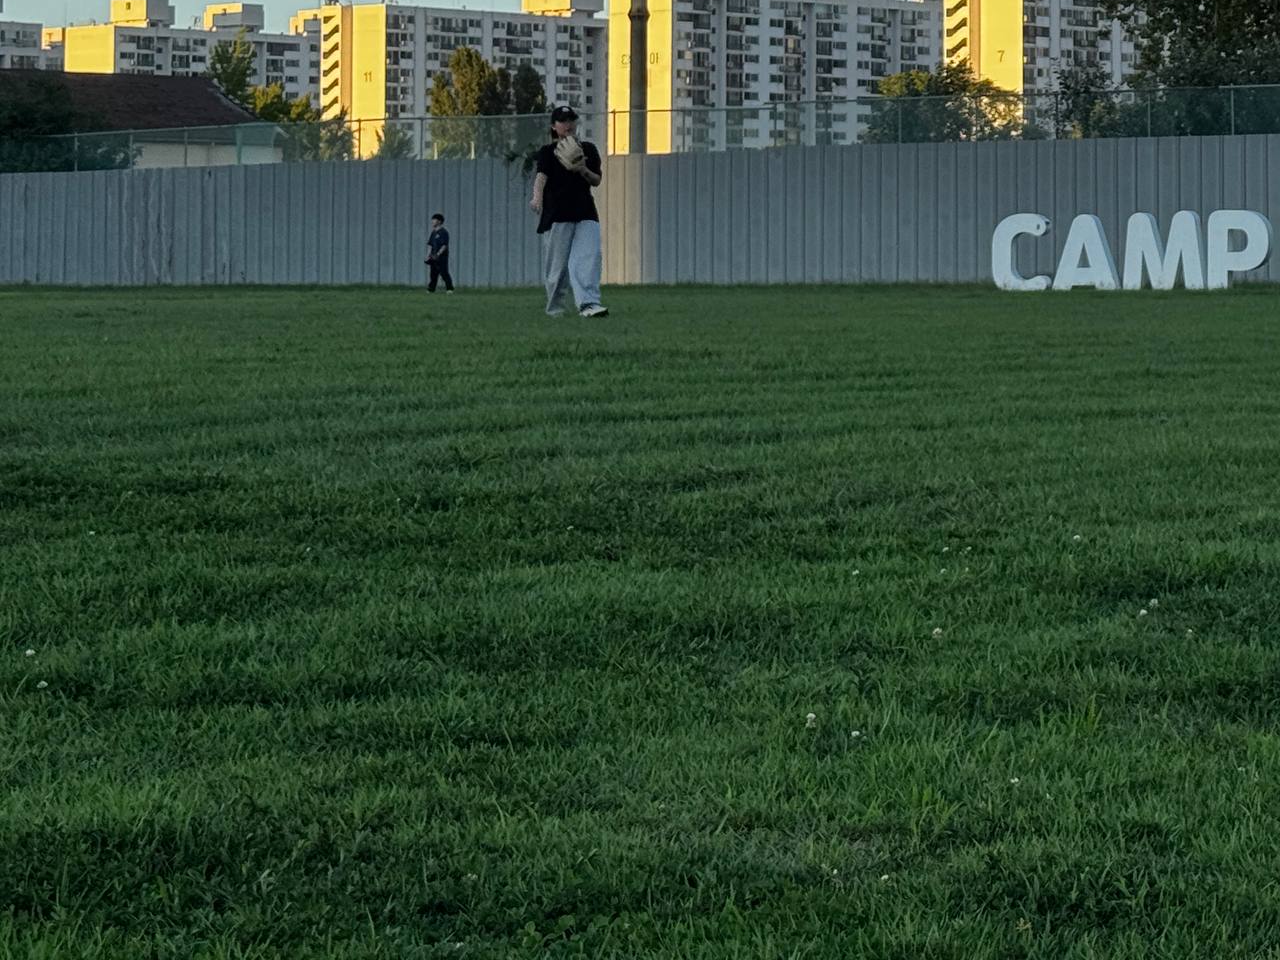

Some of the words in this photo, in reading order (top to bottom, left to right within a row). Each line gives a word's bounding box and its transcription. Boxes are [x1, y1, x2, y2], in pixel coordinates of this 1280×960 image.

[997, 50, 1005, 63] 7
[363, 71, 373, 83] 11
[991, 209, 1273, 291] CAMP
